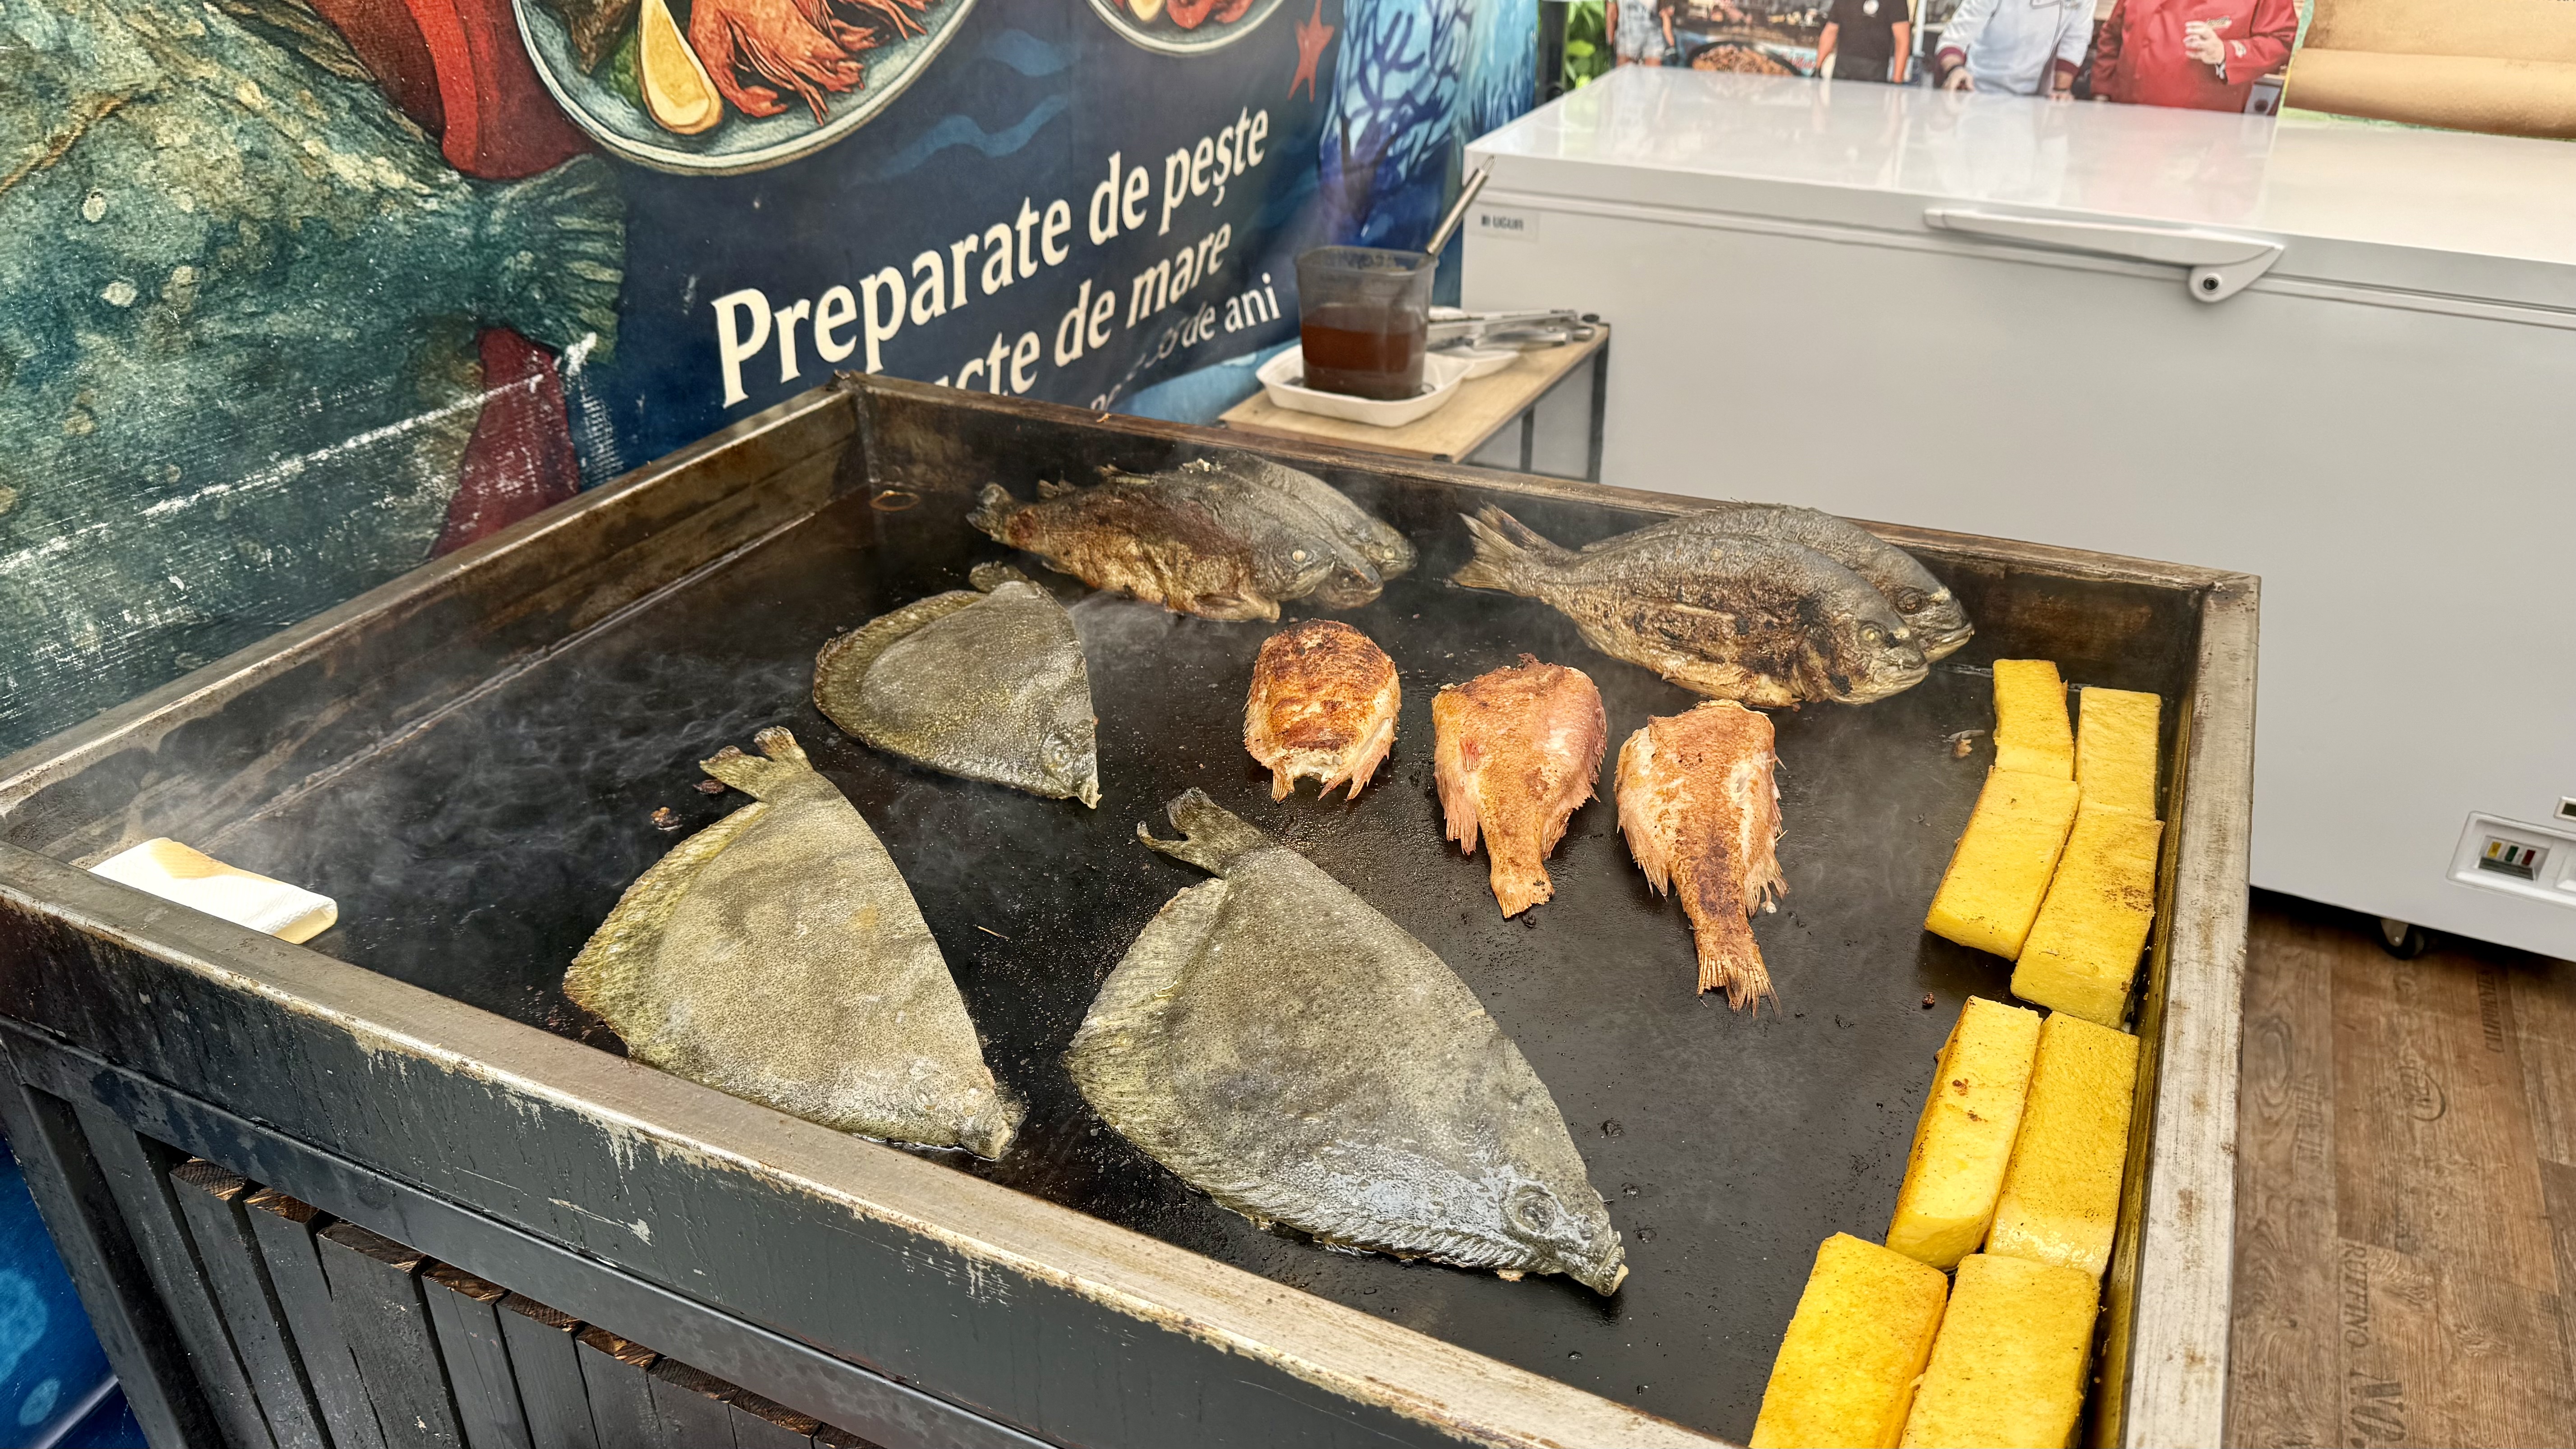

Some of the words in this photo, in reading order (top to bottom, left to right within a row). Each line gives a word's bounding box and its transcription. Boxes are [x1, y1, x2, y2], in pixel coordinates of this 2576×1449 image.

[710, 196, 1072, 408] Preparate
[1089, 151, 1148, 246] de
[1159, 106, 1269, 235] pește
[1054, 278, 1115, 367] de
[1126, 222, 1232, 329] mare
[1181, 300, 1216, 348] de
[1224, 273, 1281, 333] ani
